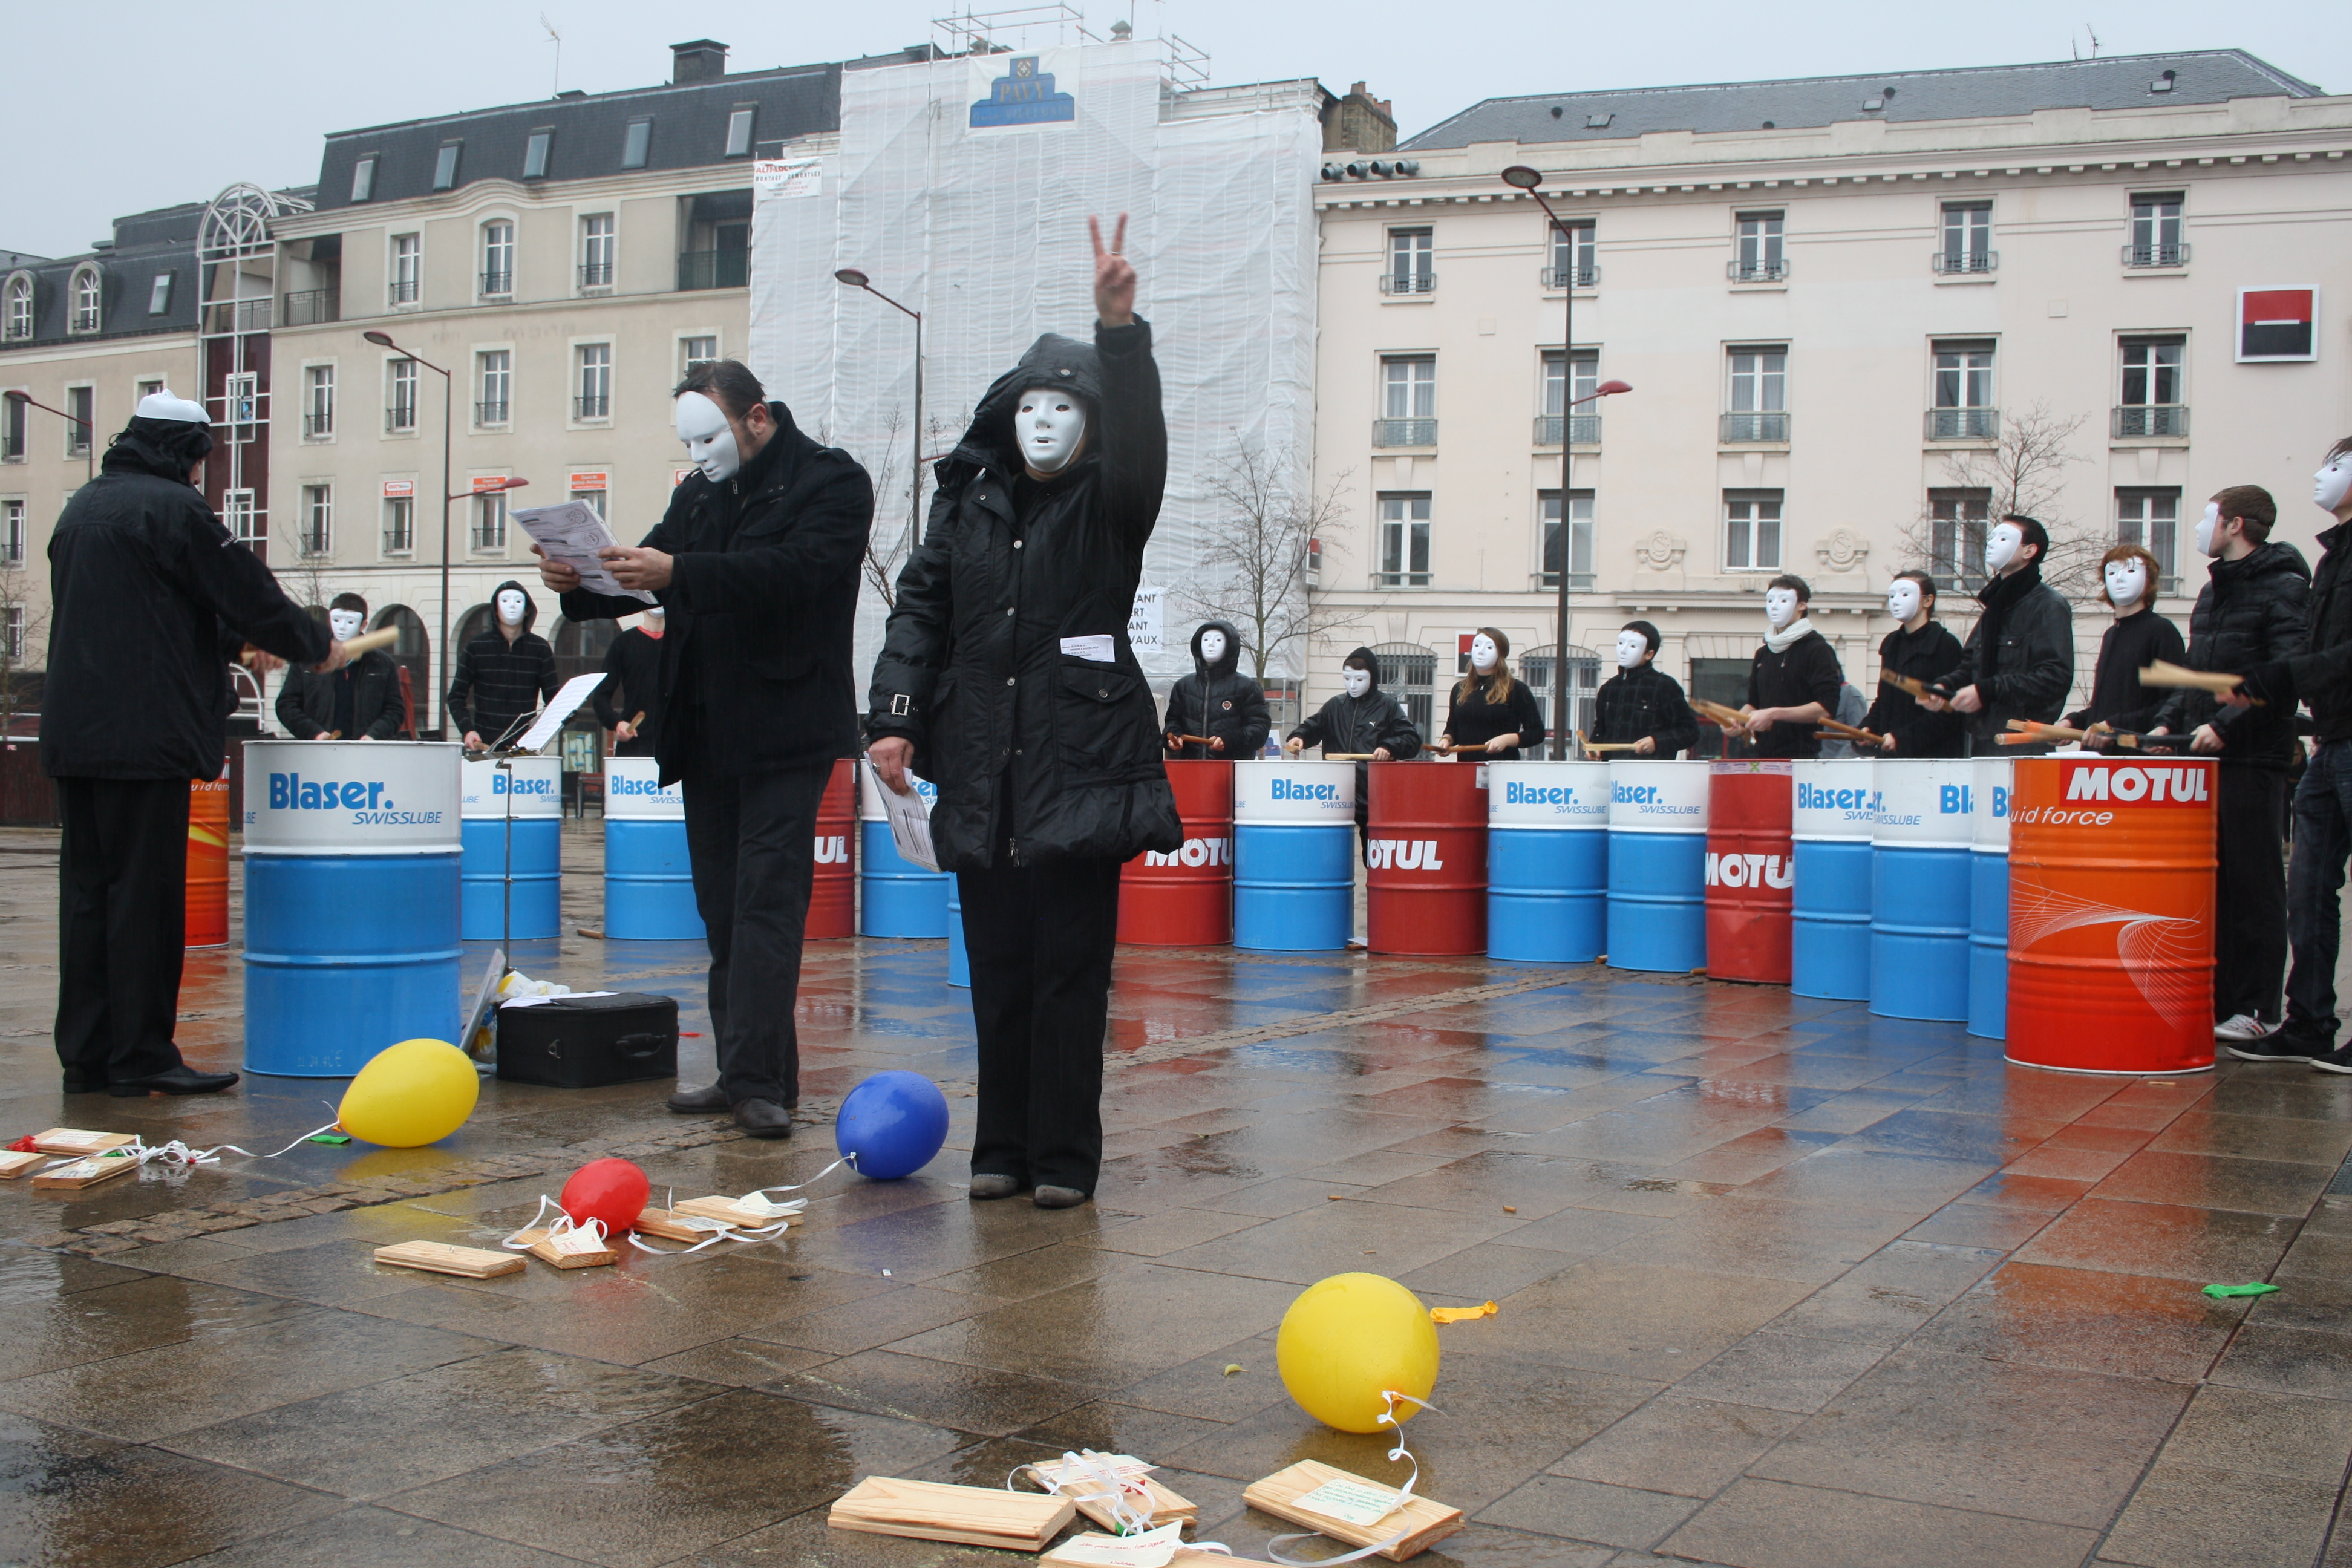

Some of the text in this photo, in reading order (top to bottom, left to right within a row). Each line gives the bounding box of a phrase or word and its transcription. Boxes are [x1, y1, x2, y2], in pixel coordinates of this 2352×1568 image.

[1000, 80, 1047, 103] PAVY
[1134, 594, 1156, 603] ANT
[270, 773, 394, 810] Blaser.
[1271, 779, 1339, 800] Blaser.
[1506, 782, 1579, 805] Blaser.
[2066, 767, 2208, 802] MOTUL
[1798, 783, 1873, 810] Blaser.
[352, 812, 442, 825] SWISSLUBE
[1638, 805, 1701, 814] SWISSLUBE
[2010, 806, 2114, 825] uid force
[1367, 839, 1443, 871] OTUL
[1705, 852, 1792, 889] MOTU
